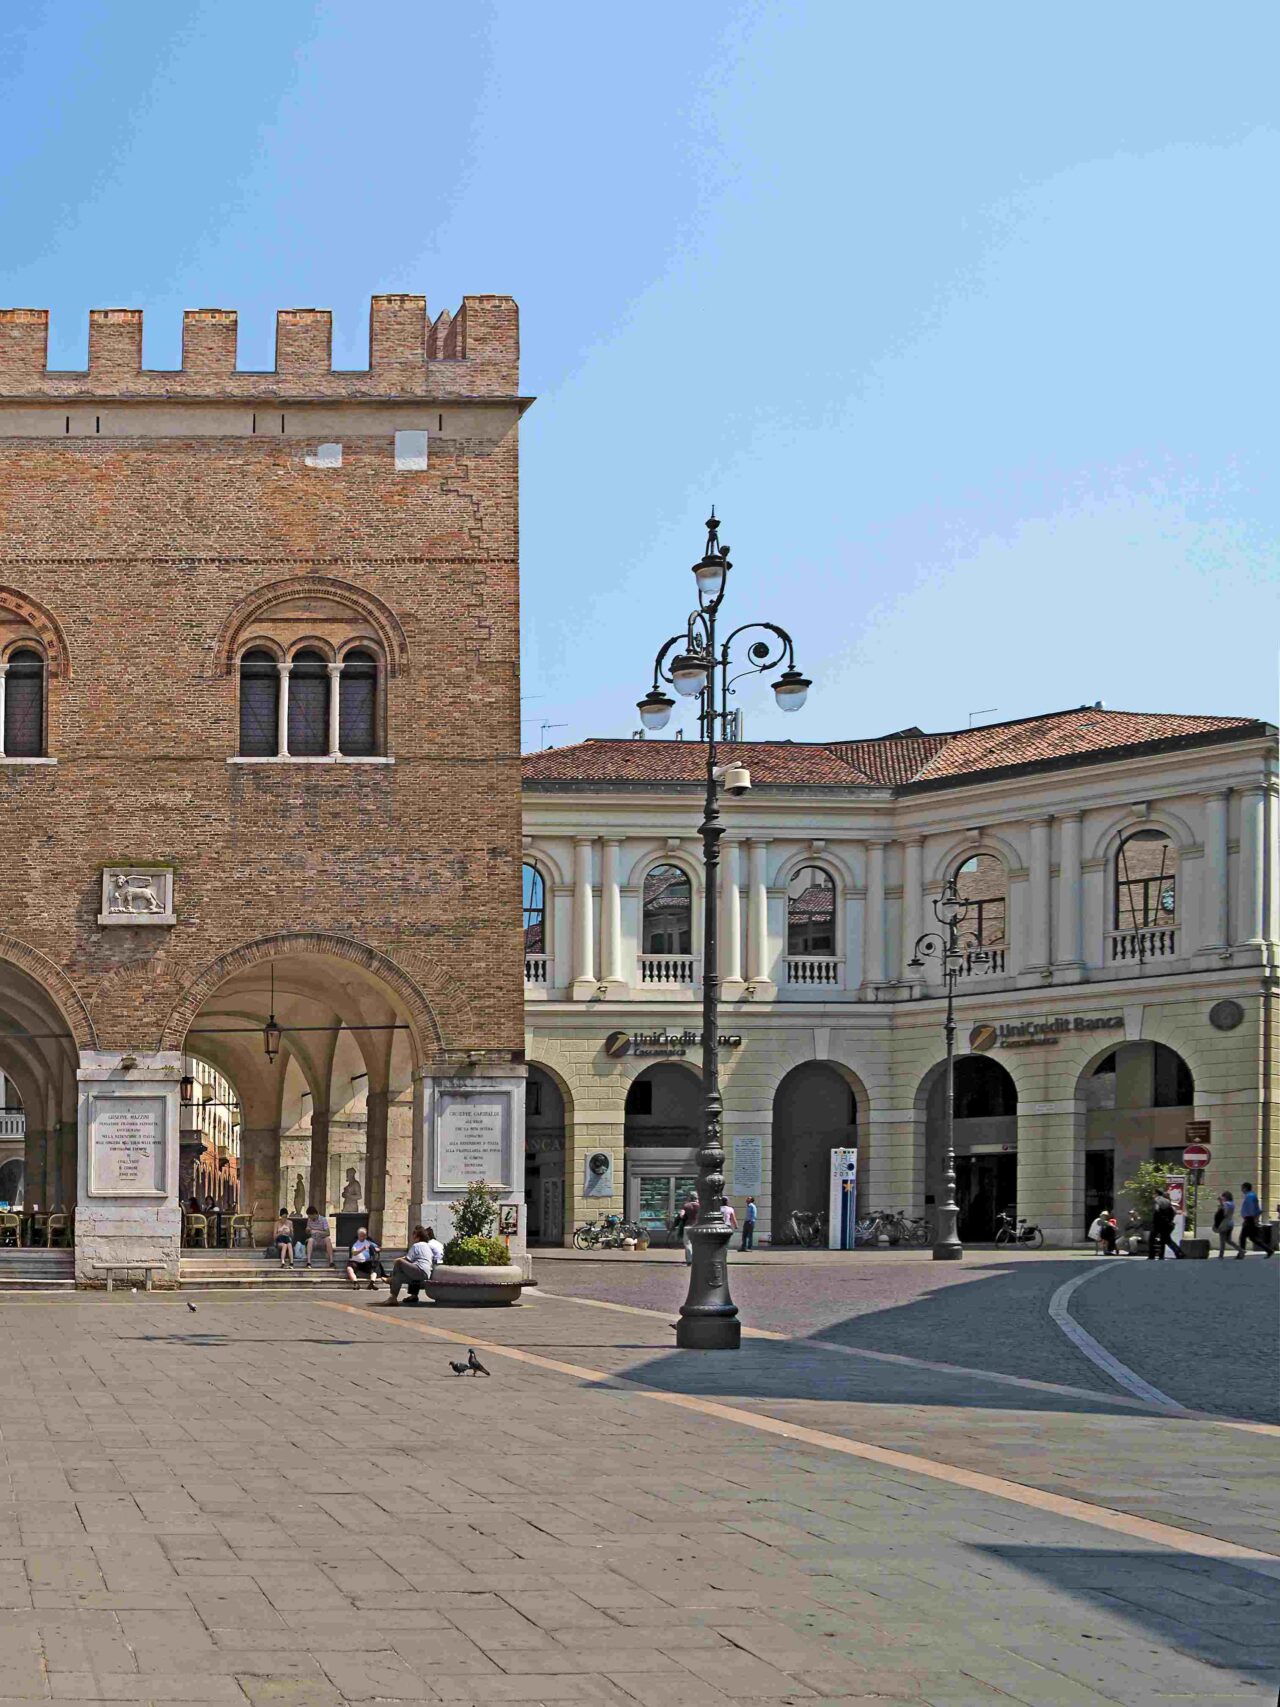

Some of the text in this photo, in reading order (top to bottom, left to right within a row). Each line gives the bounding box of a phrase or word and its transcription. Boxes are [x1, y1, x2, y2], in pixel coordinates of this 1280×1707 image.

[999, 1016, 1124, 1038] UniCredit Banca
[634, 1031, 697, 1047] UniCredit
